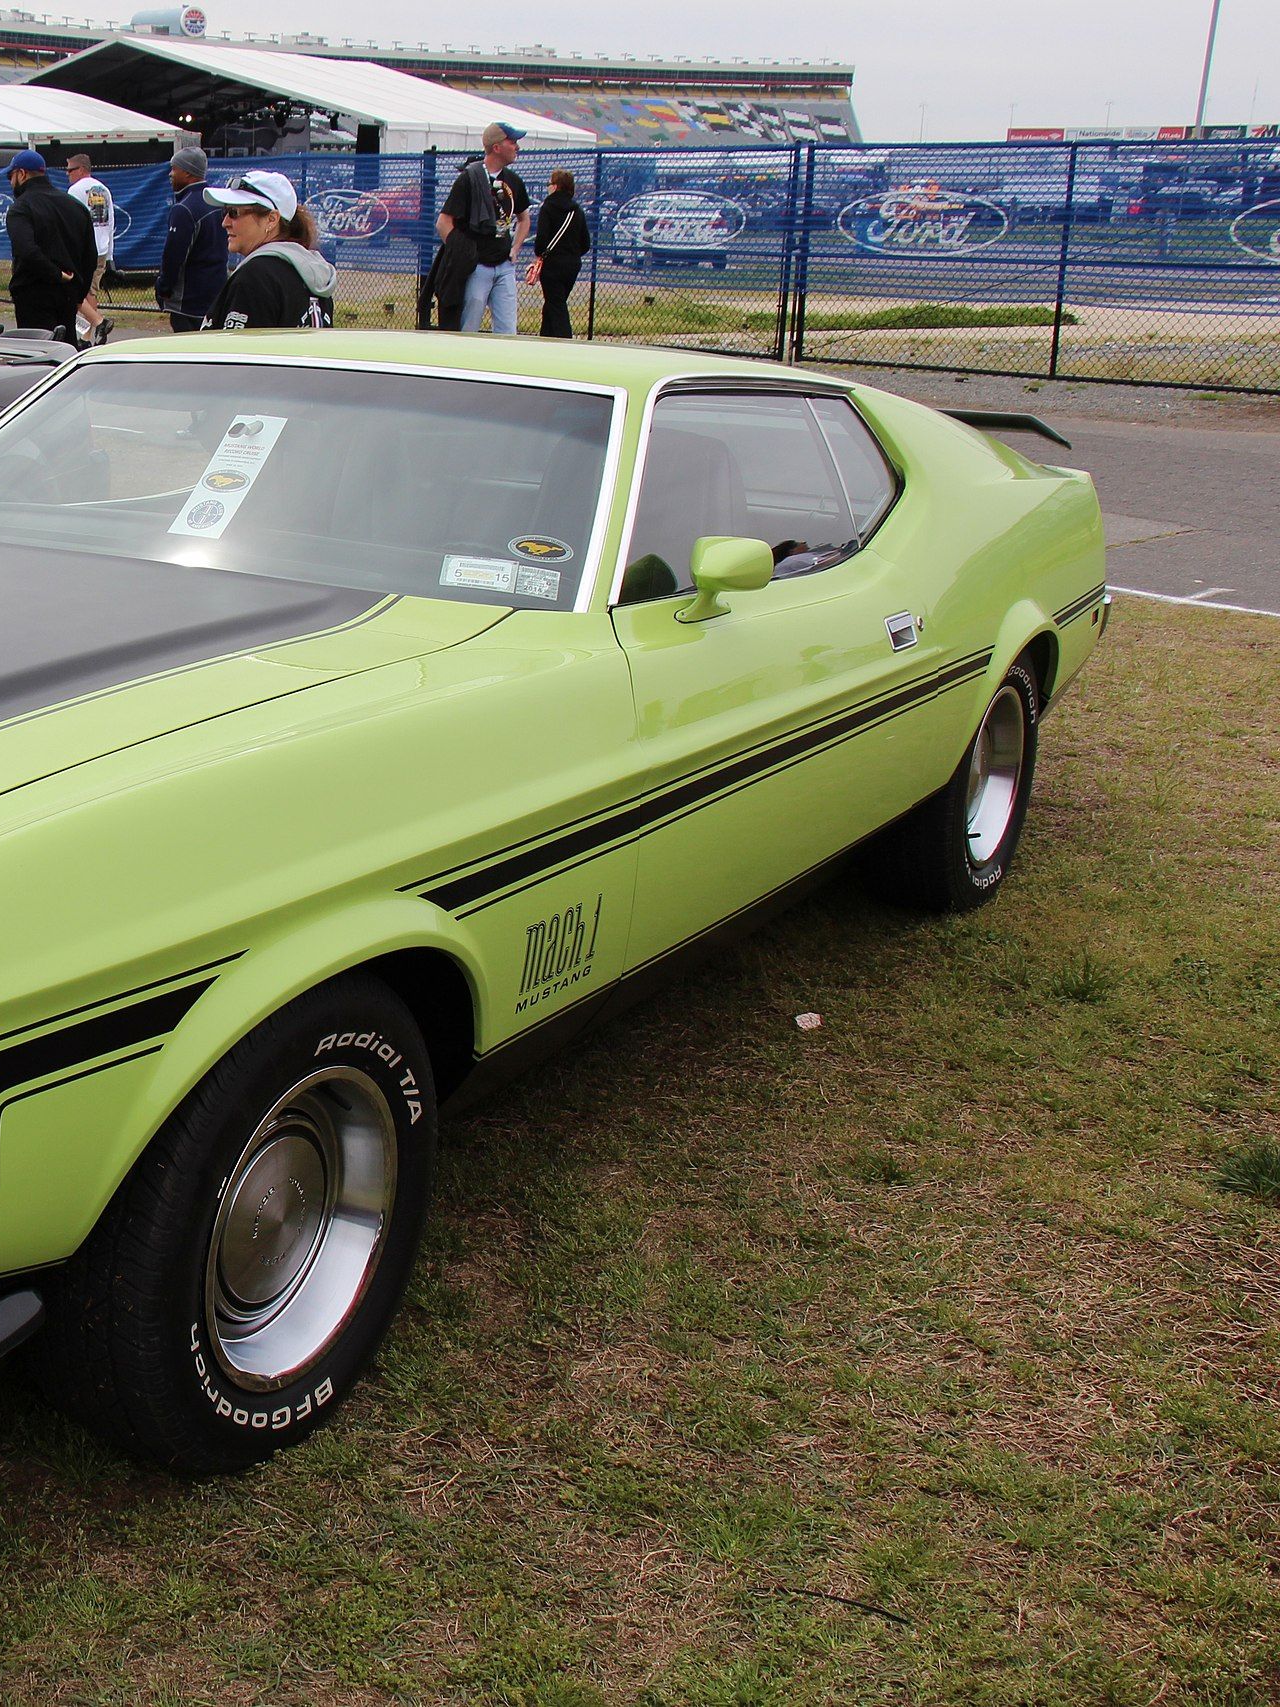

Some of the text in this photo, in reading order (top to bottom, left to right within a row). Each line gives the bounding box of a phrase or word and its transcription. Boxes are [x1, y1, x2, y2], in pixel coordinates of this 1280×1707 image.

[1078, 129, 1121, 139] Nationwide
[319, 194, 373, 232] Ford
[867, 199, 976, 245] Ford
[454, 569, 463, 578] 5
[495, 574, 510, 583] 15
[972, 865, 1002, 890] Radial
[515, 965, 592, 1014] MUSTANG
[314, 1031, 424, 1126] Radial T/A
[189, 1322, 335, 1430] BFGoodrich
